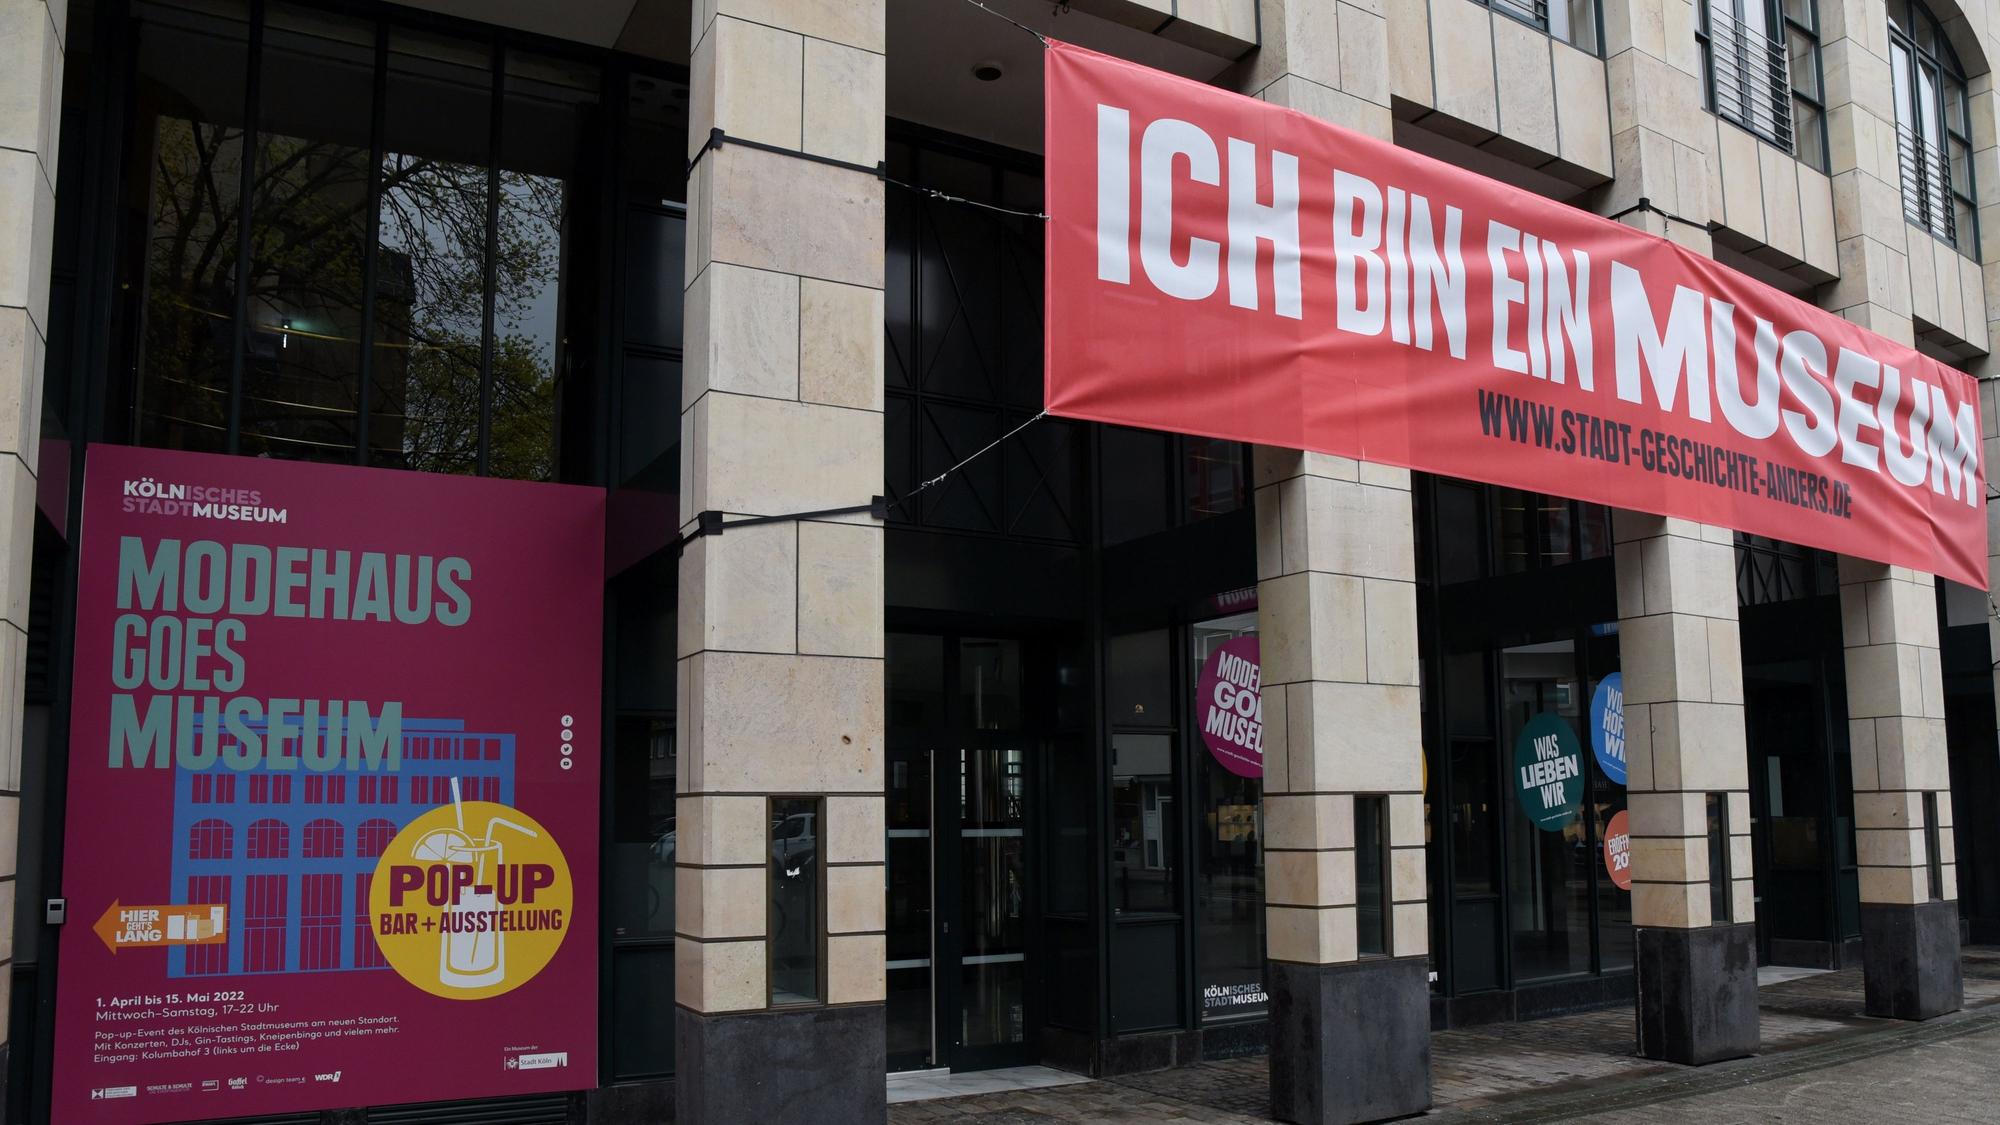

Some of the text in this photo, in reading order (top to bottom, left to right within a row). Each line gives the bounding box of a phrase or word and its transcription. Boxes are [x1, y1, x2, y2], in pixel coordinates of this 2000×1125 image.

[1096, 103, 1978, 508] ICH BIN EIN MUSEUM
[1478, 388, 1852, 520] WWW.STADT-GESCHICHTE-ANDERS.DE
[123, 477, 262, 506] KÖLNISCHES
[122, 497, 287, 524] STADTMUSEUM
[116, 535, 472, 627] MODEHAUS
[111, 613, 246, 693] GOES
[108, 693, 402, 772] MUSEUM
[1533, 734, 1559, 761] WAS
[1521, 754, 1579, 790] LIEBEN
[1540, 781, 1566, 809] WIR
[1613, 851, 1630, 872] 20
[389, 864, 555, 907] POP-UP
[120, 910, 160, 922] HIER
[126, 921, 153, 931] GEHT'S
[380, 913, 418, 935] BAR
[439, 909, 562, 934] AUSSTELLUNG
[115, 929, 162, 942] LANG
[96, 991, 245, 1009] 1. April bis 15. Mai 2022
[1204, 983, 1261, 998] KÖLNISCHES
[258, 1003, 280, 1013] Uhr
[94, 1026, 400, 1051] Mit Konzerten, DJs, Gin-Tastings, Kneipenbingo und vielem mehr.
[95, 1028, 165, 1040] Pop-up-Event
[168, 1027, 185, 1036] des
[187, 1024, 238, 1035] Kölnischen
[241, 1021, 309, 1031] Stadtmuseums
[328, 1018, 356, 1026] neuen
[358, 1015, 400, 1025] Standort.
[94, 1041, 300, 1064] Eingang: Kolumbahof 3 (links um die Ecke)
[521, 1058, 537, 1066] Stadt
